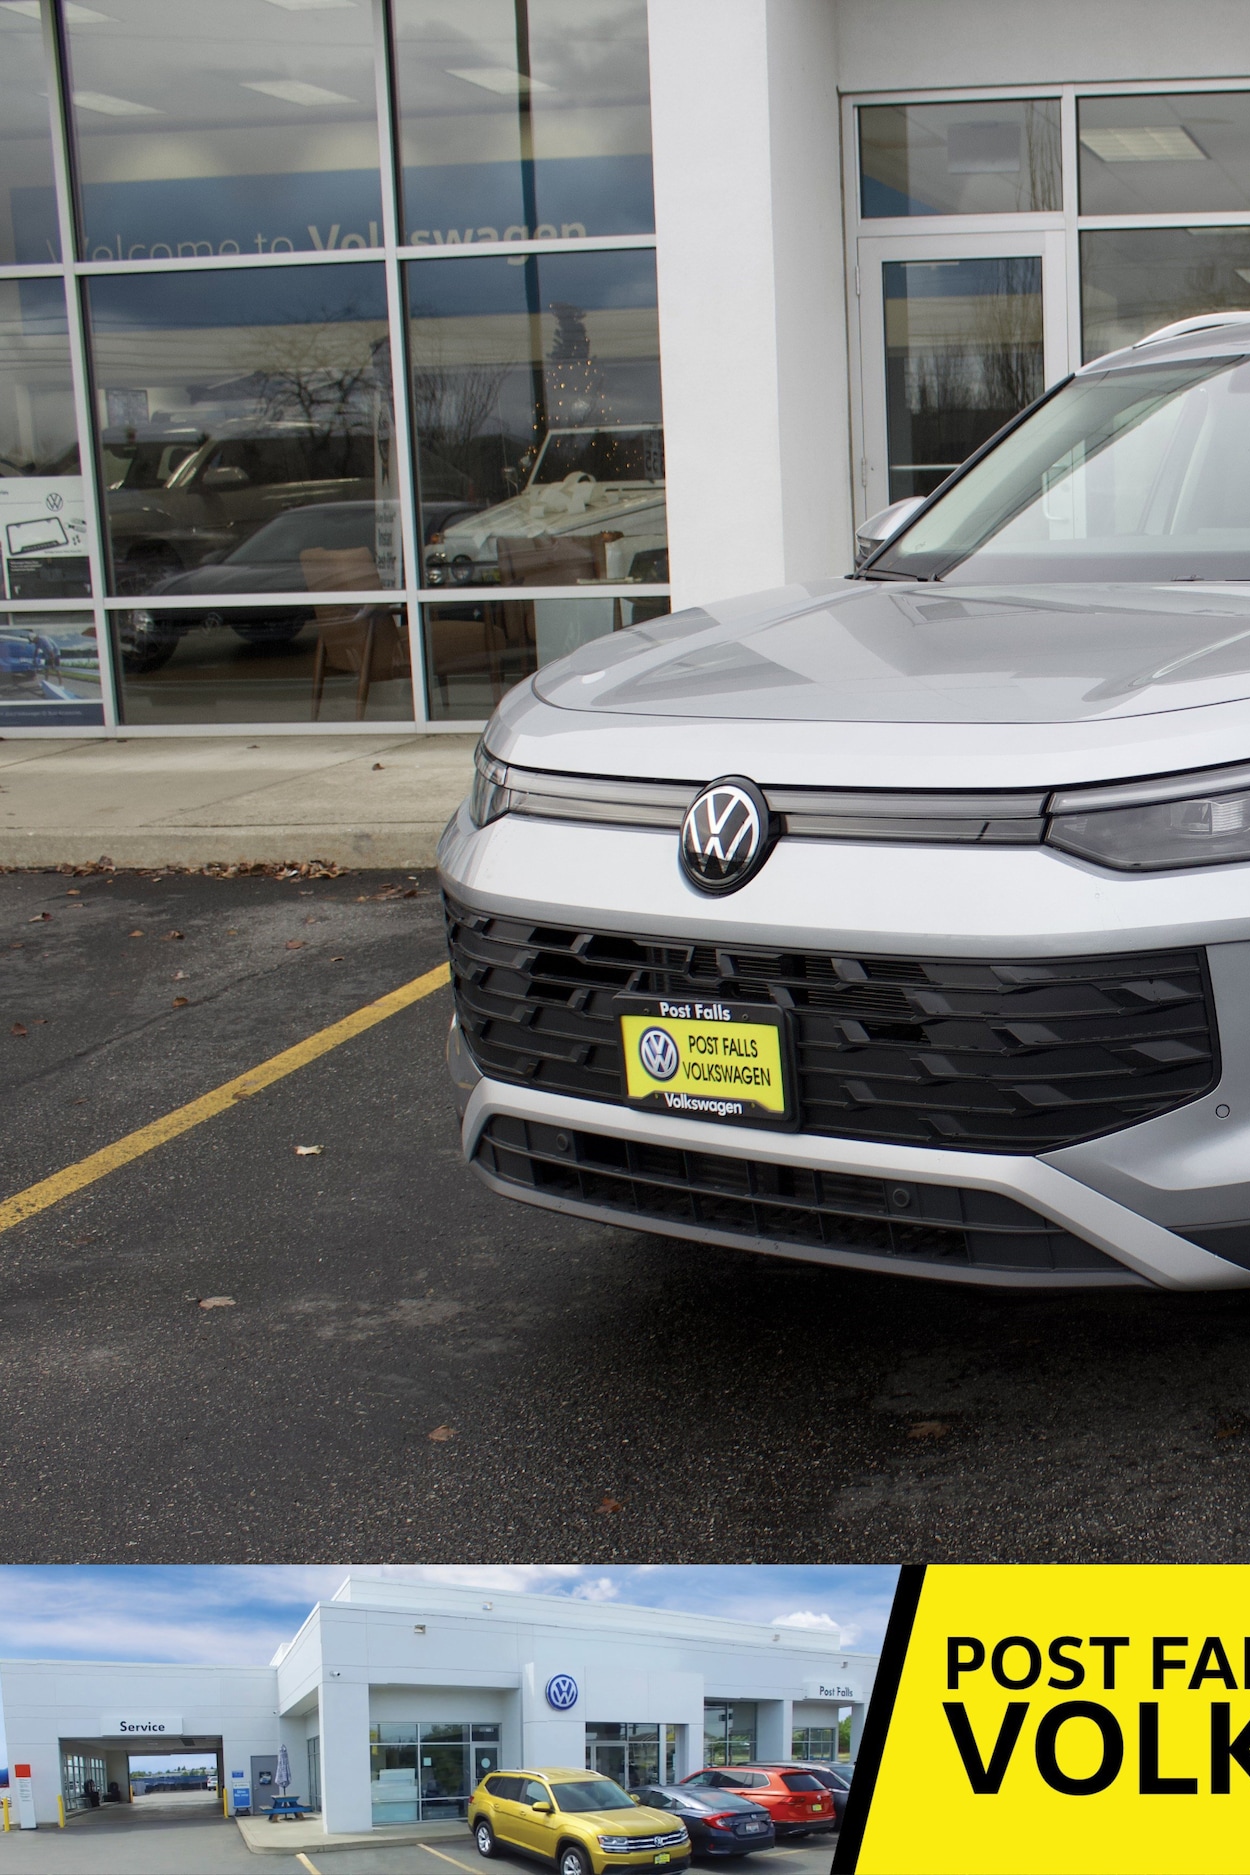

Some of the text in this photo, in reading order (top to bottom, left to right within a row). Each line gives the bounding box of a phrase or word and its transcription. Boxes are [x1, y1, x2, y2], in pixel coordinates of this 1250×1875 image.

[254, 233, 294, 254] to
[307, 221, 587, 266] Volswagen
[659, 1001, 731, 1021] Post Falls
[688, 1035, 758, 1058] POST FALLS
[682, 1061, 771, 1087] VOLKSWAGEN
[664, 1092, 743, 1117] Volkswagen
